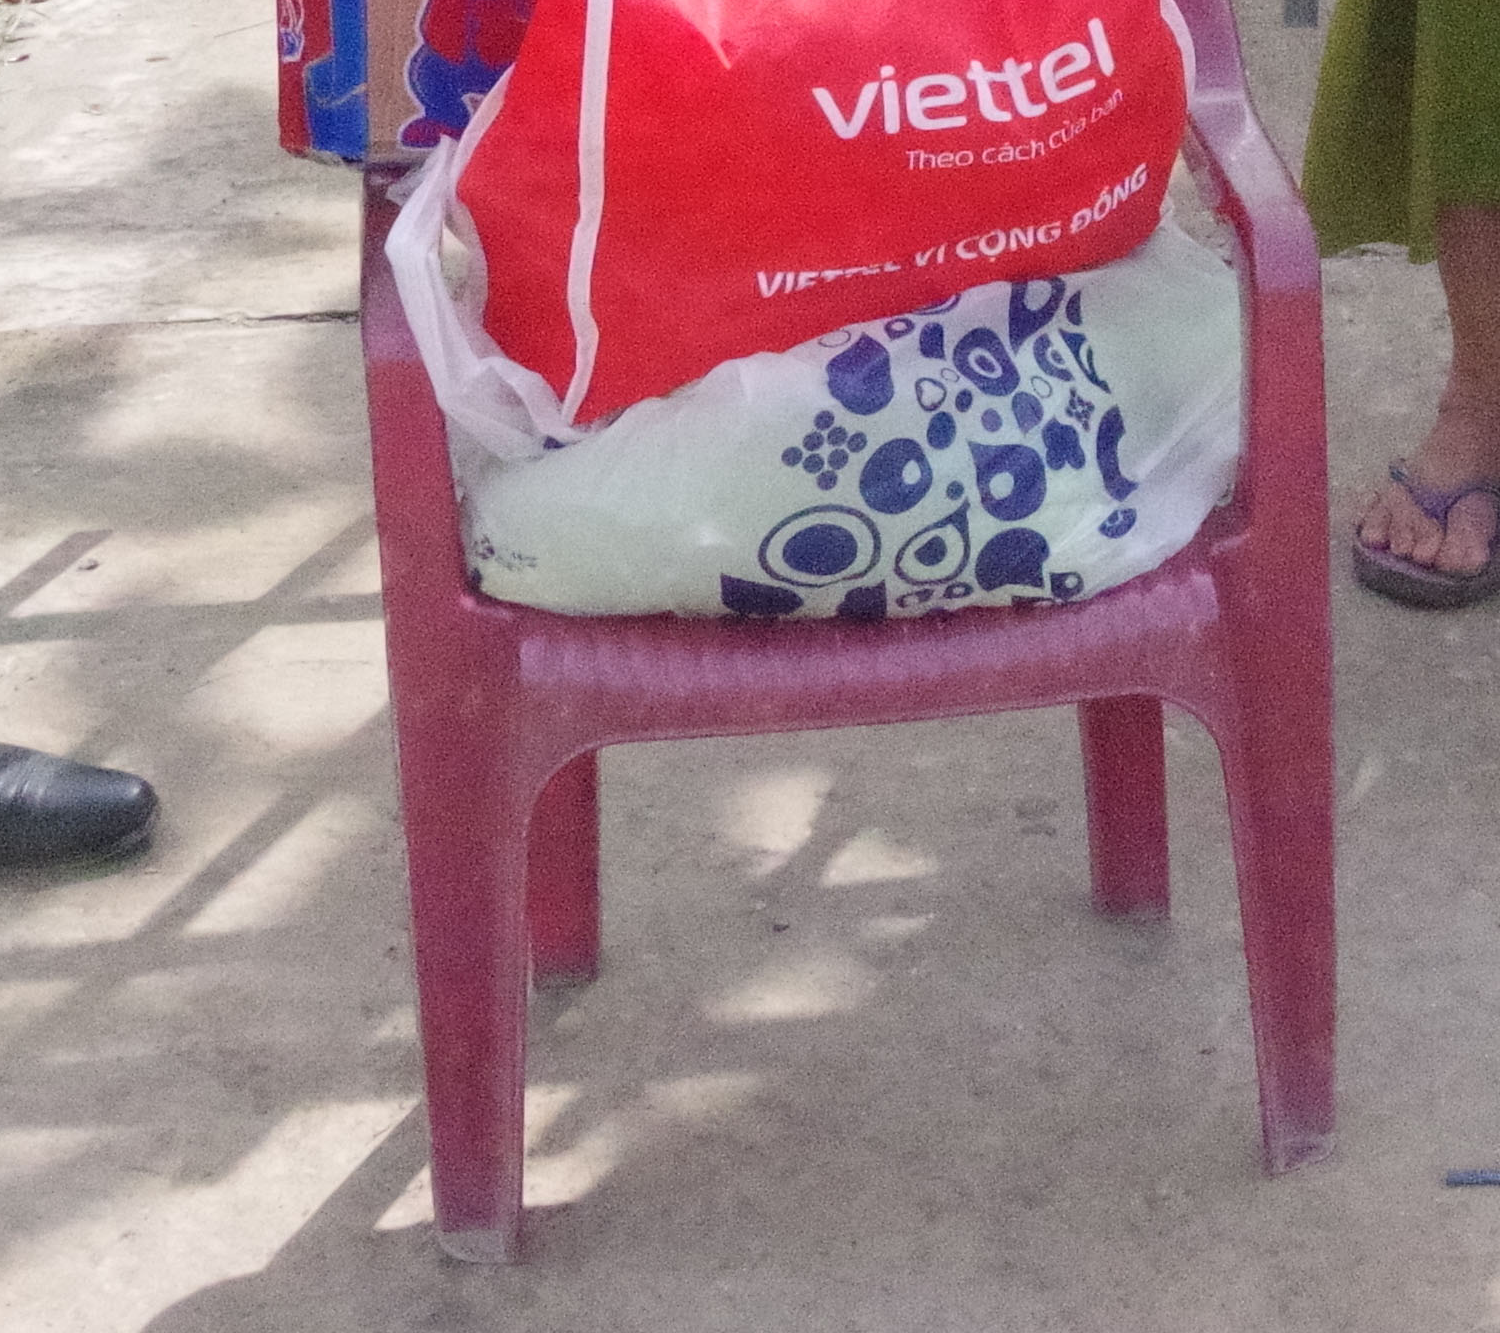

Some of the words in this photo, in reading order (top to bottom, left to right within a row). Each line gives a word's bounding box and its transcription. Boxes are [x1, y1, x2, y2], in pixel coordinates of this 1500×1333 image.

[811, 17, 1117, 140] viettel
[905, 149, 974, 170] Theo
[982, 140, 1046, 164] cách
